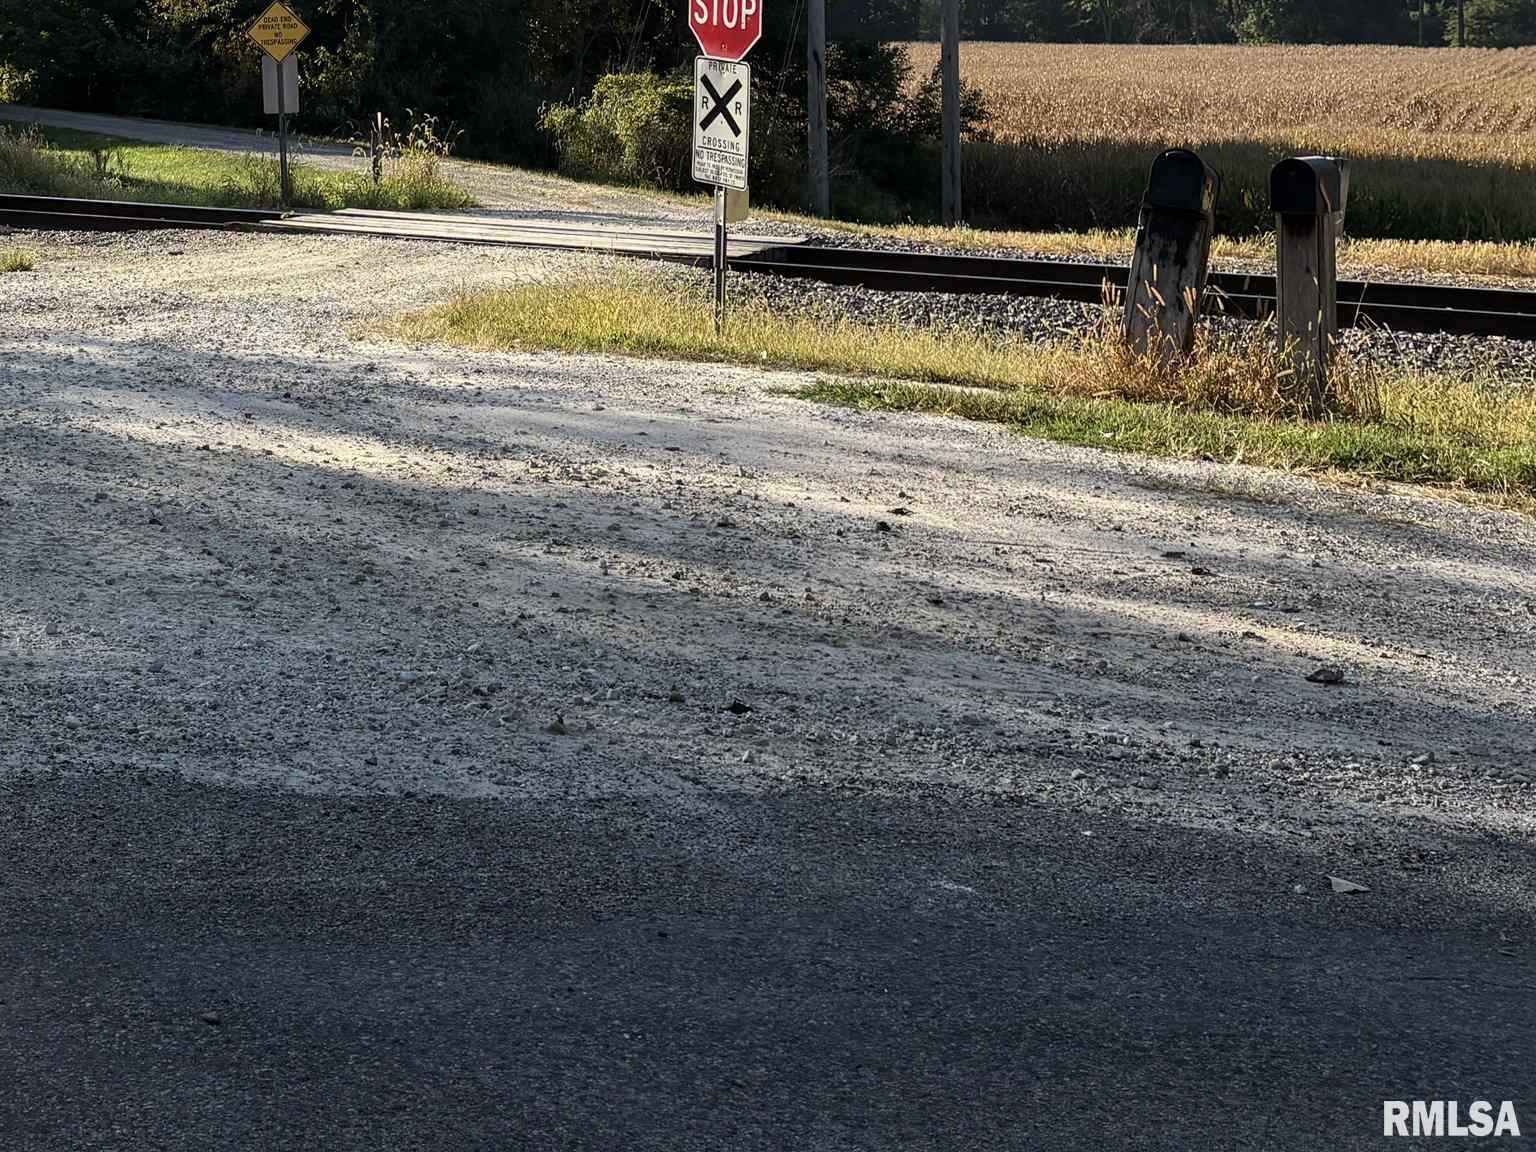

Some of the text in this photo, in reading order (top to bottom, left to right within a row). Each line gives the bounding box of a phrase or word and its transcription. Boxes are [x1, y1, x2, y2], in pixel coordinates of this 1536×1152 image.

[280, 15, 292, 23] END
[708, 61, 737, 74] PRIVATE
[701, 95, 742, 116] R R
[702, 136, 740, 152] CROSSING
[695, 149, 705, 160] NO
[706, 150, 745, 168] TRESPASSING
